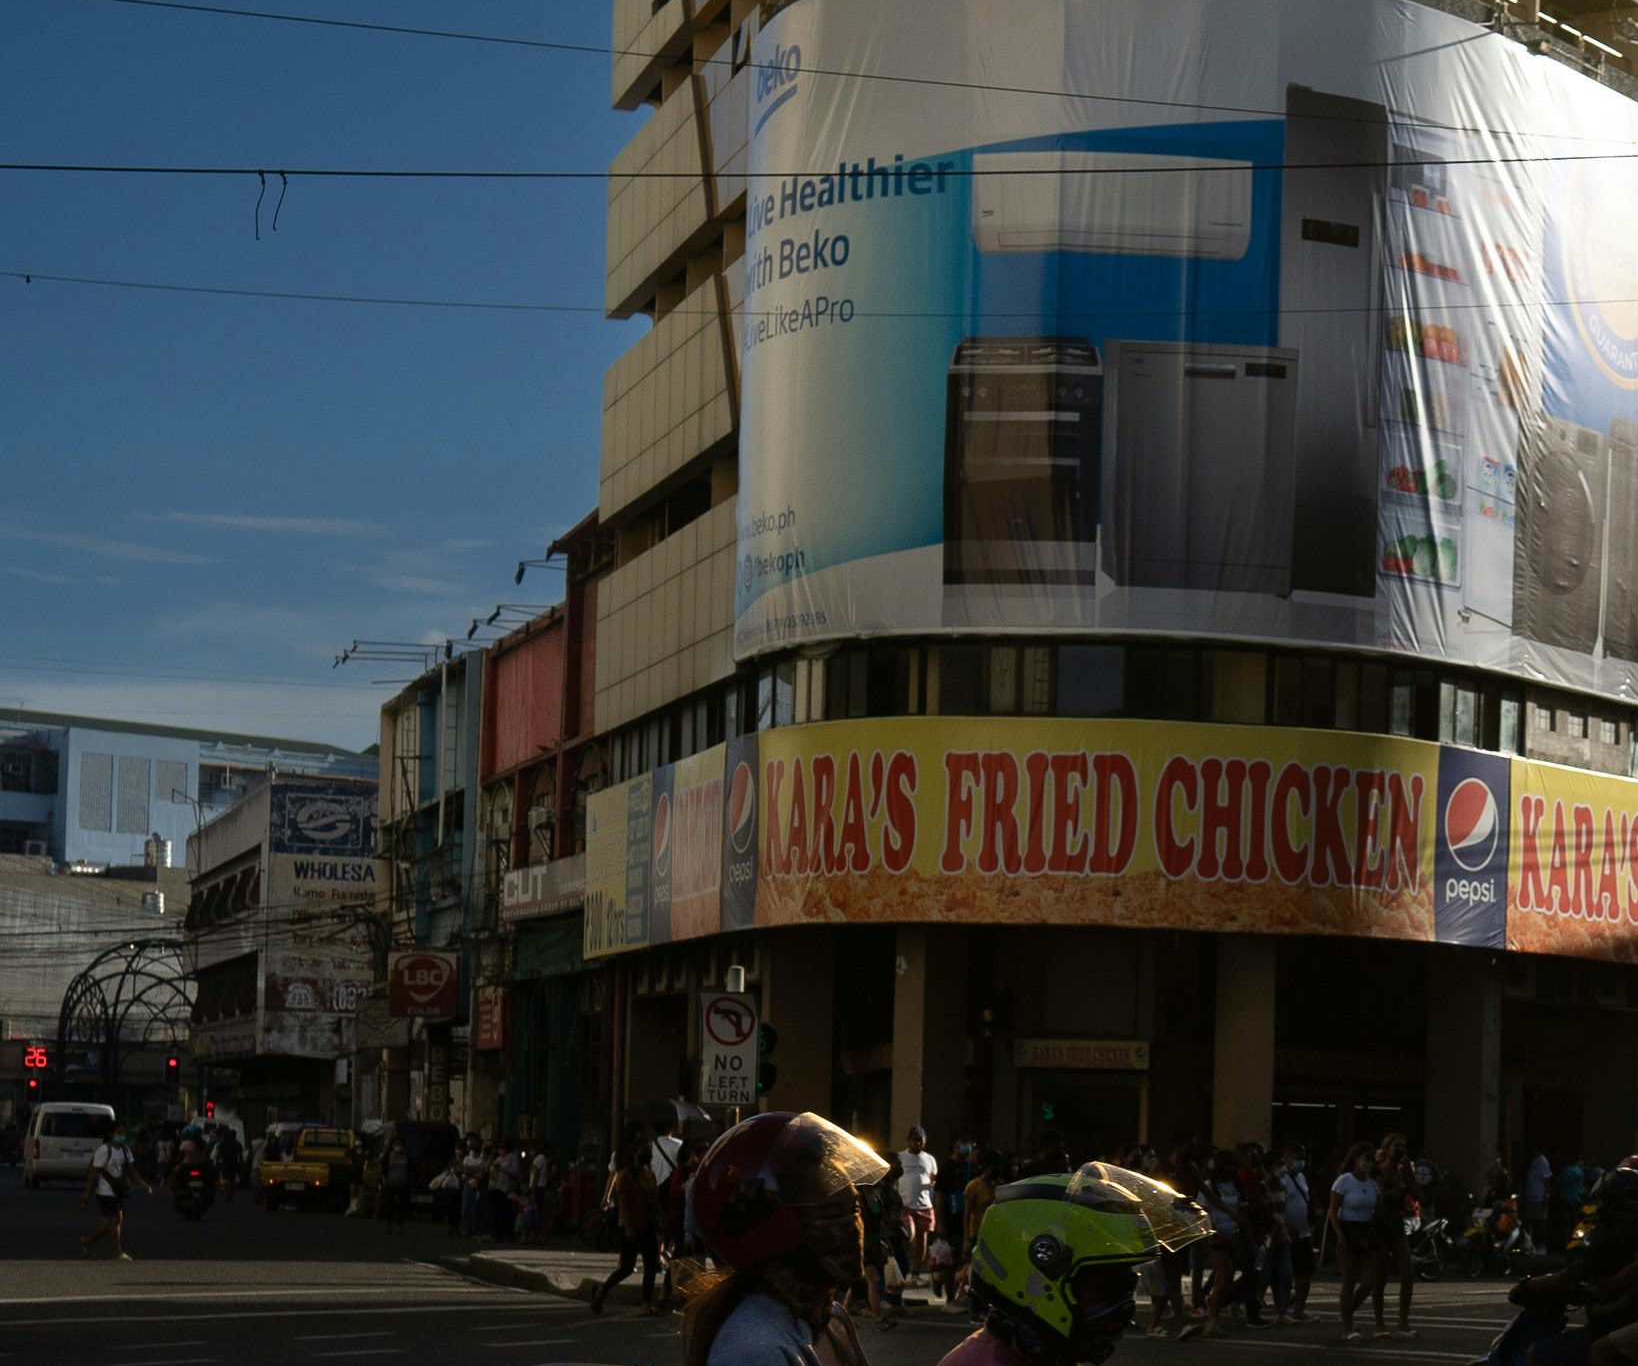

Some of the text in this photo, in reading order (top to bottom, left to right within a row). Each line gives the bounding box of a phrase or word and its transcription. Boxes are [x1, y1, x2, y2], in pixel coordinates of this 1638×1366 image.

[779, 154, 954, 221] Healthier
[779, 229, 850, 281] Beko
[762, 748, 917, 878] KARA'S
[940, 749, 1138, 877] FRIED
[1155, 755, 1425, 894] CHICKEN
[294, 860, 376, 882] WHOLESA
[729, 855, 754, 886] pepsi
[504, 865, 548, 907] CUT
[1445, 876, 1496, 907] pepsi
[403, 968, 444, 986] LBC
[407, 1006, 441, 1016] COLON
[24, 1047, 48, 1068] 26
[714, 1054, 743, 1071] NO
[708, 1075, 748, 1089] LEFT
[708, 1089, 750, 1103] TURN
